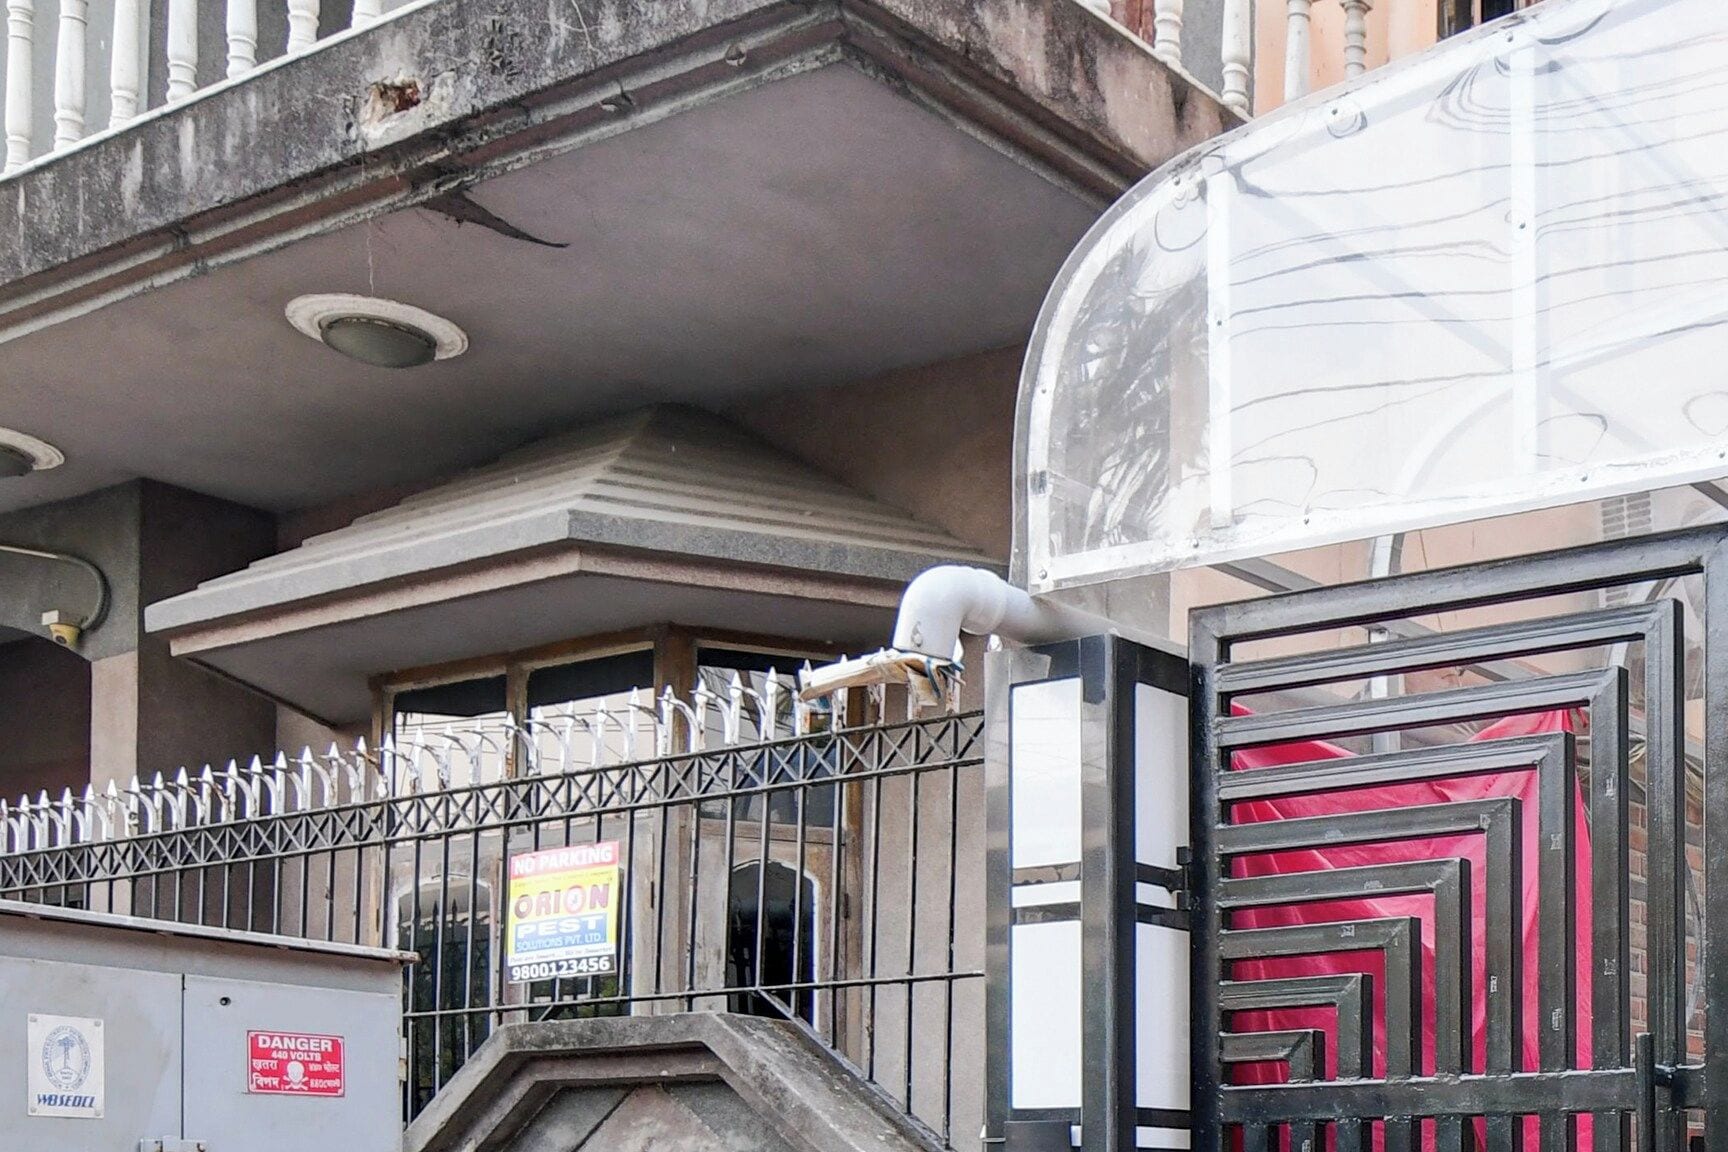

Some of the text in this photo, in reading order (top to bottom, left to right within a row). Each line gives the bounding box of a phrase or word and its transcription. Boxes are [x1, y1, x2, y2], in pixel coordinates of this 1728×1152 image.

[514, 845, 613, 874] NO PARKING
[514, 883, 610, 919] ORION
[516, 915, 605, 938] PEST
[516, 936, 564, 952] SOLUTIONS
[511, 956, 611, 981] 9800123456
[258, 1035, 333, 1052] DANGER
[271, 1050, 322, 1062] 440 VOLTS
[37, 1094, 96, 1108] WBSEDCL
